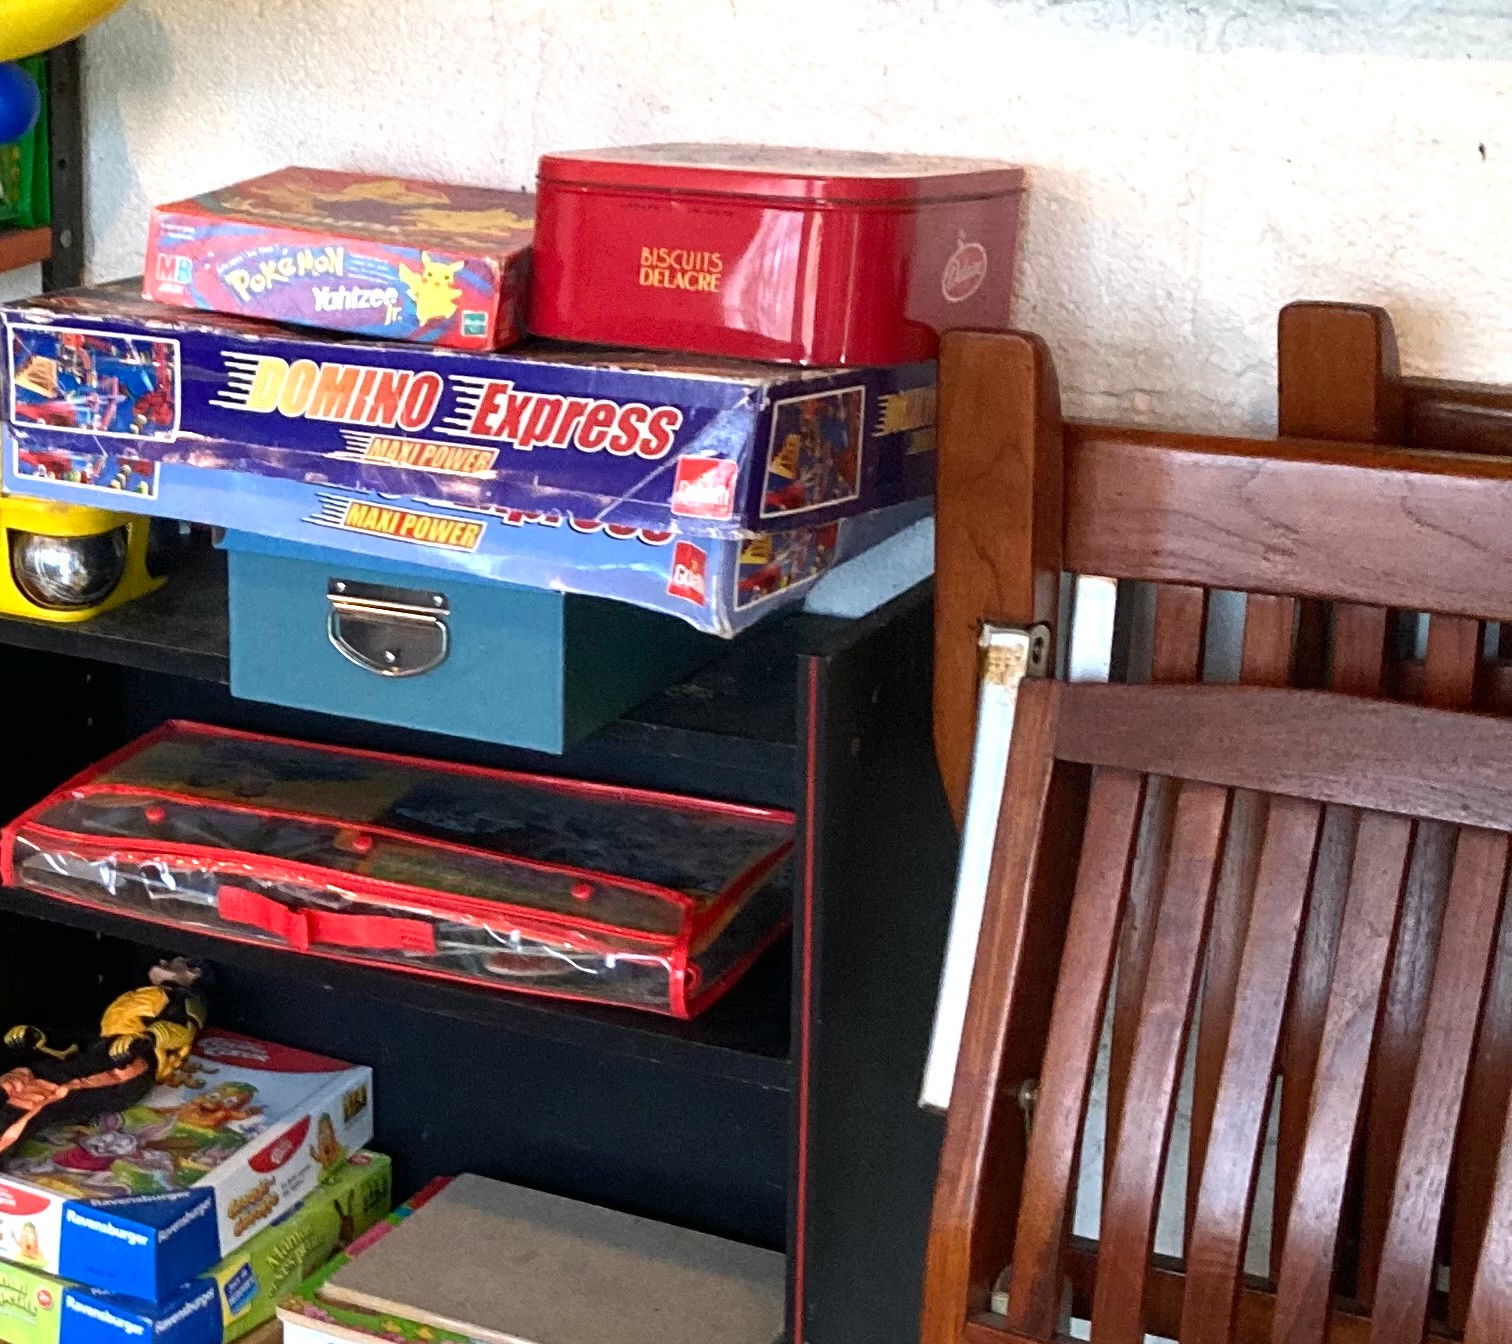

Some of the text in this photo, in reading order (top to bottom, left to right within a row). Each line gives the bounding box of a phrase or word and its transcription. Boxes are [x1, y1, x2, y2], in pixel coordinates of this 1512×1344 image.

[156, 253, 193, 285] MB
[641, 247, 723, 273] BISCUITS
[639, 266, 722, 293] DELACRE
[312, 285, 399, 312] Yahtzee
[246, 356, 683, 459] DOMINO Express
[365, 436, 494, 472] MAXI POWER
[344, 501, 400, 534] MAXI
[400, 510, 481, 551] POWER
[66, 1207, 150, 1246] Ravensburger
[65, 1294, 145, 1336] Ravensburger
